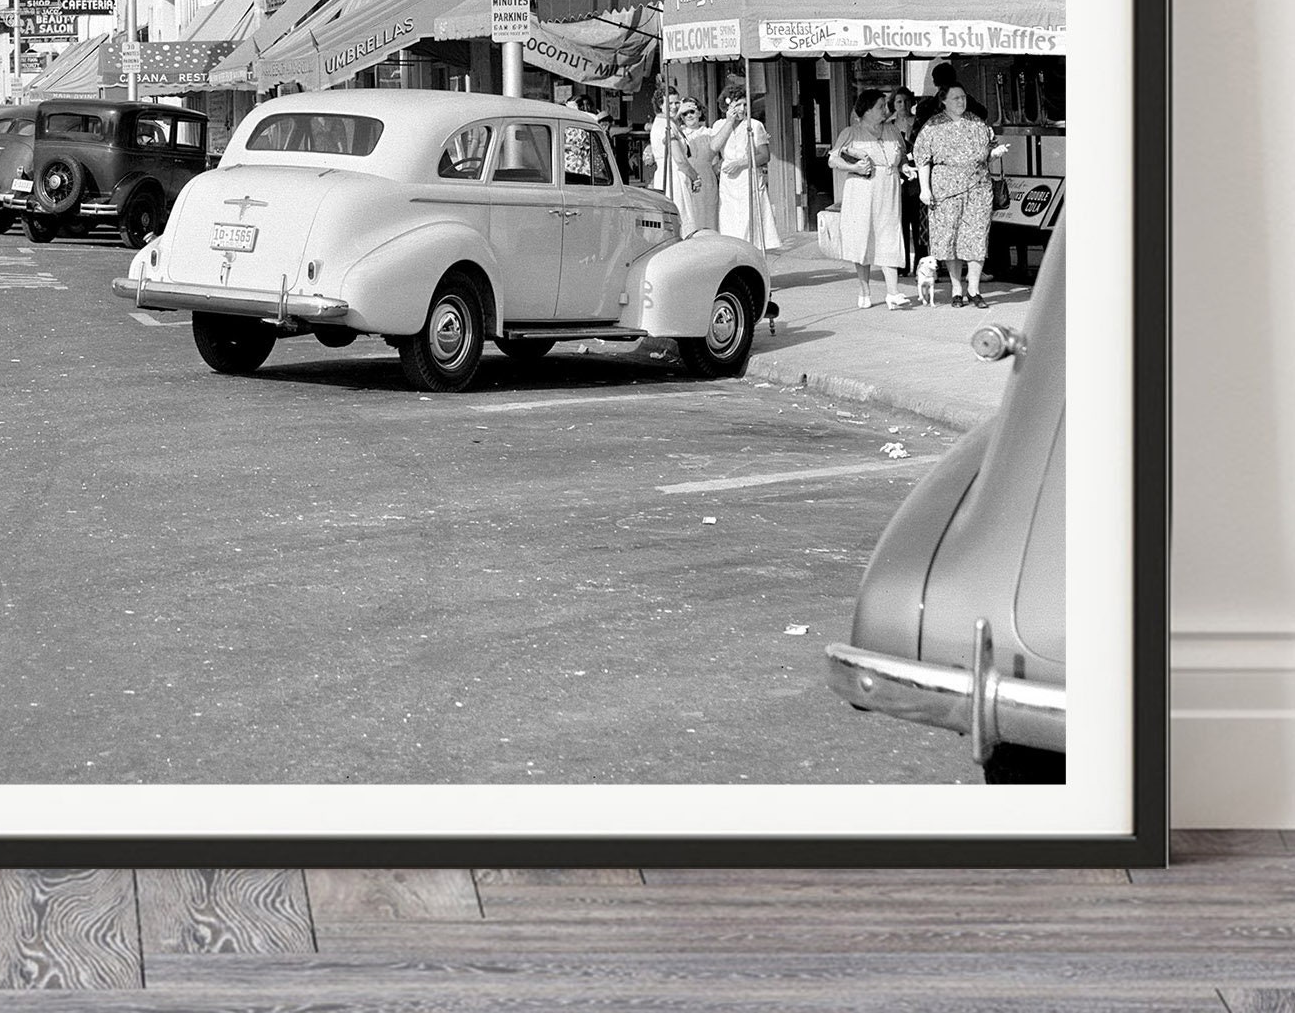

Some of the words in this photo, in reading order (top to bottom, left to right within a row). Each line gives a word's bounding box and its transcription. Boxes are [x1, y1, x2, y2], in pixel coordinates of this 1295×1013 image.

[62, 0, 114, 10] CAFETERIA
[36, 15, 76, 24] BEAUTY
[493, 12, 528, 22] PARKING
[39, 24, 75, 34] SALON
[766, 21, 812, 35] Breakfast
[862, 24, 932, 48] Delicious
[939, 25, 984, 51] Tasty
[987, 25, 1057, 50] Waffles
[324, 16, 415, 75] UMBRELLAS
[665, 26, 719, 53] WELCOME
[523, 37, 593, 72] OCONUT
